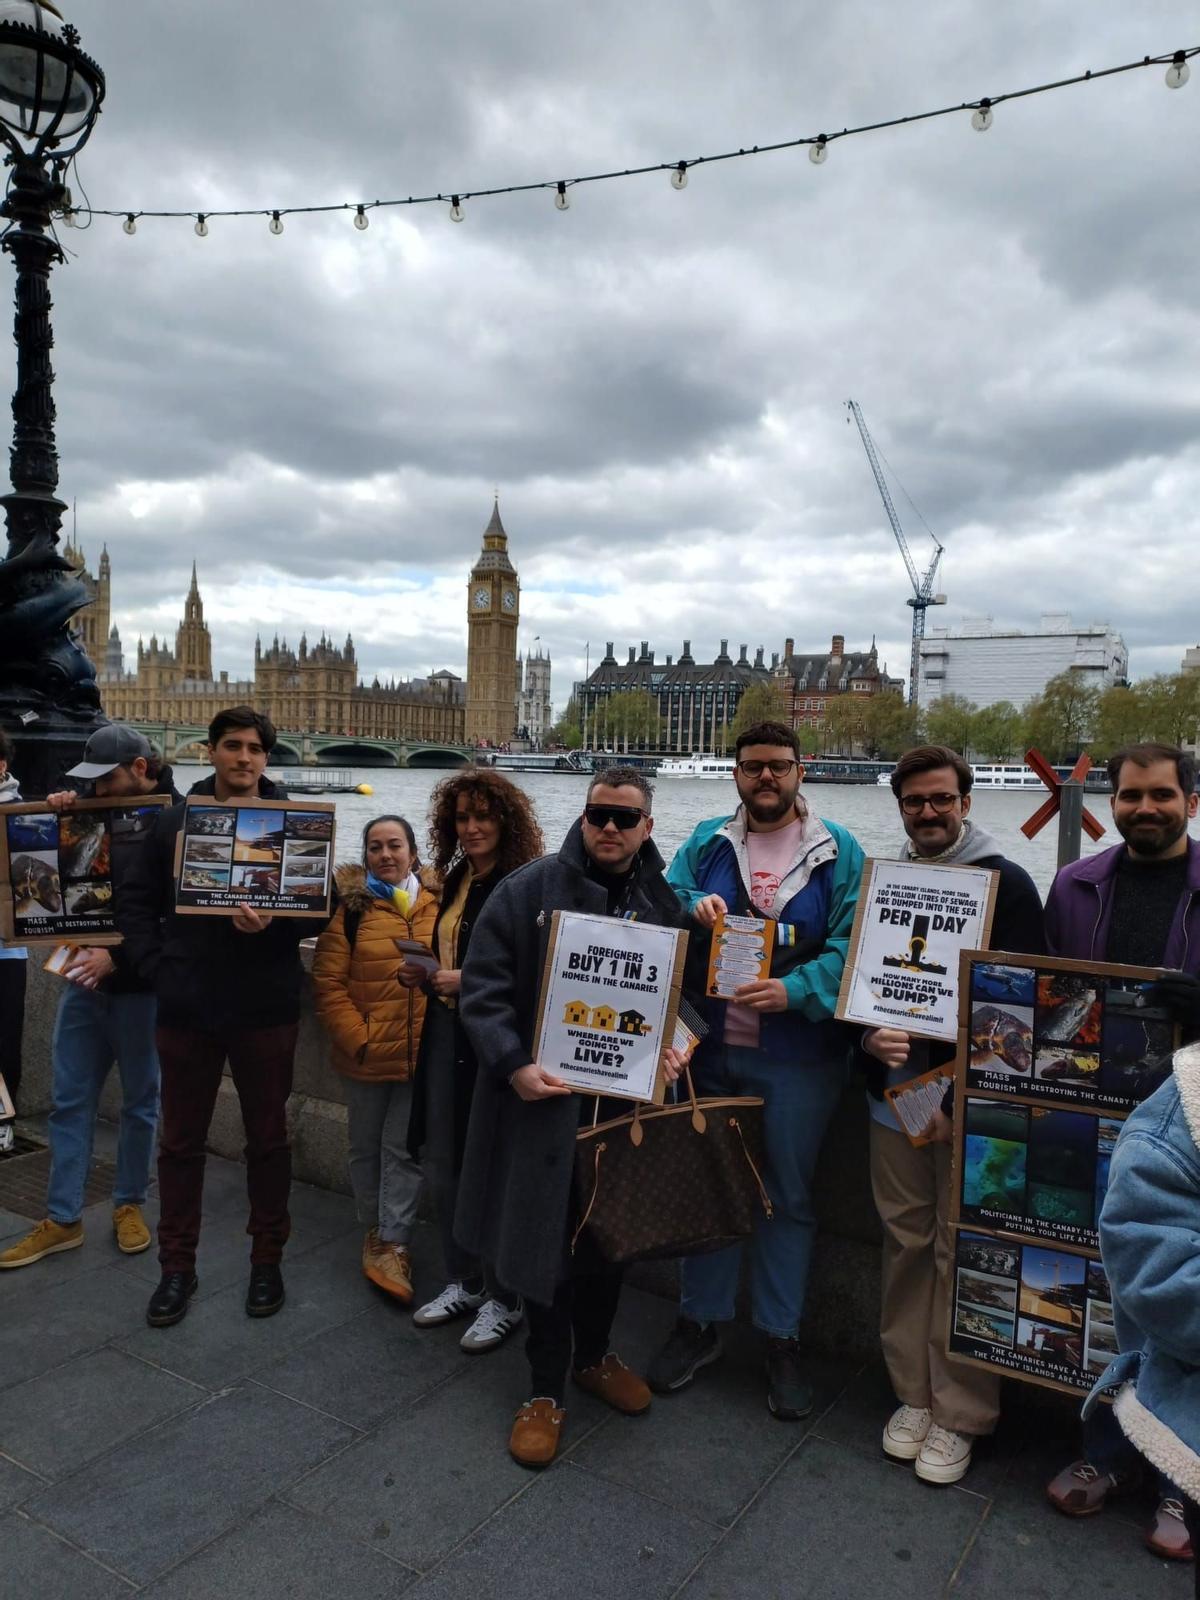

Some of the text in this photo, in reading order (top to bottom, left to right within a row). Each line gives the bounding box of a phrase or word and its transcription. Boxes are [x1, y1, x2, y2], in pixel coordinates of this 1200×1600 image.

[875, 897, 977, 916] ARE DUMPED INTO THE SEA
[891, 891, 916, 899] MILLION
[918, 894, 938, 902] LITRES
[950, 898, 978, 907] SEWAGE
[879, 908, 967, 934] PER DAY
[588, 945, 644, 963] FOREIGNERS
[569, 952, 657, 982] BUY 1 IN 3
[562, 971, 658, 993] HOMES IN THE CANARIES
[871, 977, 953, 997] MILLIONS CAN WE
[922, 979, 942, 987] MORE
[882, 987, 937, 1006] DUMP?
[568, 1030, 634, 1046] WHERE ARE WE
[579, 1039, 607, 1049] GOING
[574, 1047, 624, 1067] LIVE?
[560, 1062, 628, 1080] #thecanarieshavealimit
[985, 1071, 1010, 1082] MASS
[978, 1081, 1016, 1092] TOURISM
[1031, 1084, 1077, 1096] DESTROYING
[1098, 1094, 1129, 1104] CANARY
[980, 1209, 1022, 1222] POLITICIANS
[1036, 1220, 1049, 1228] THE
[1052, 1224, 1080, 1234] CANARY
[1084, 1229, 1100, 1238] ISLA
[1006, 1222, 1035, 1232] PUTTING
[1038, 1228, 1056, 1237] YOUR
[1060, 1234, 1074, 1242] LIFE
[974, 1351, 987, 1360] THE
[991, 1355, 1020, 1369] CANARY
[1023, 1364, 1055, 1378] ISLANDS
[1059, 1374, 1073, 1384] ARE
[992, 1347, 1005, 1356] THE
[1008, 1351, 1044, 1366] CANARIES
[1049, 1362, 1068, 1374] HAVE
